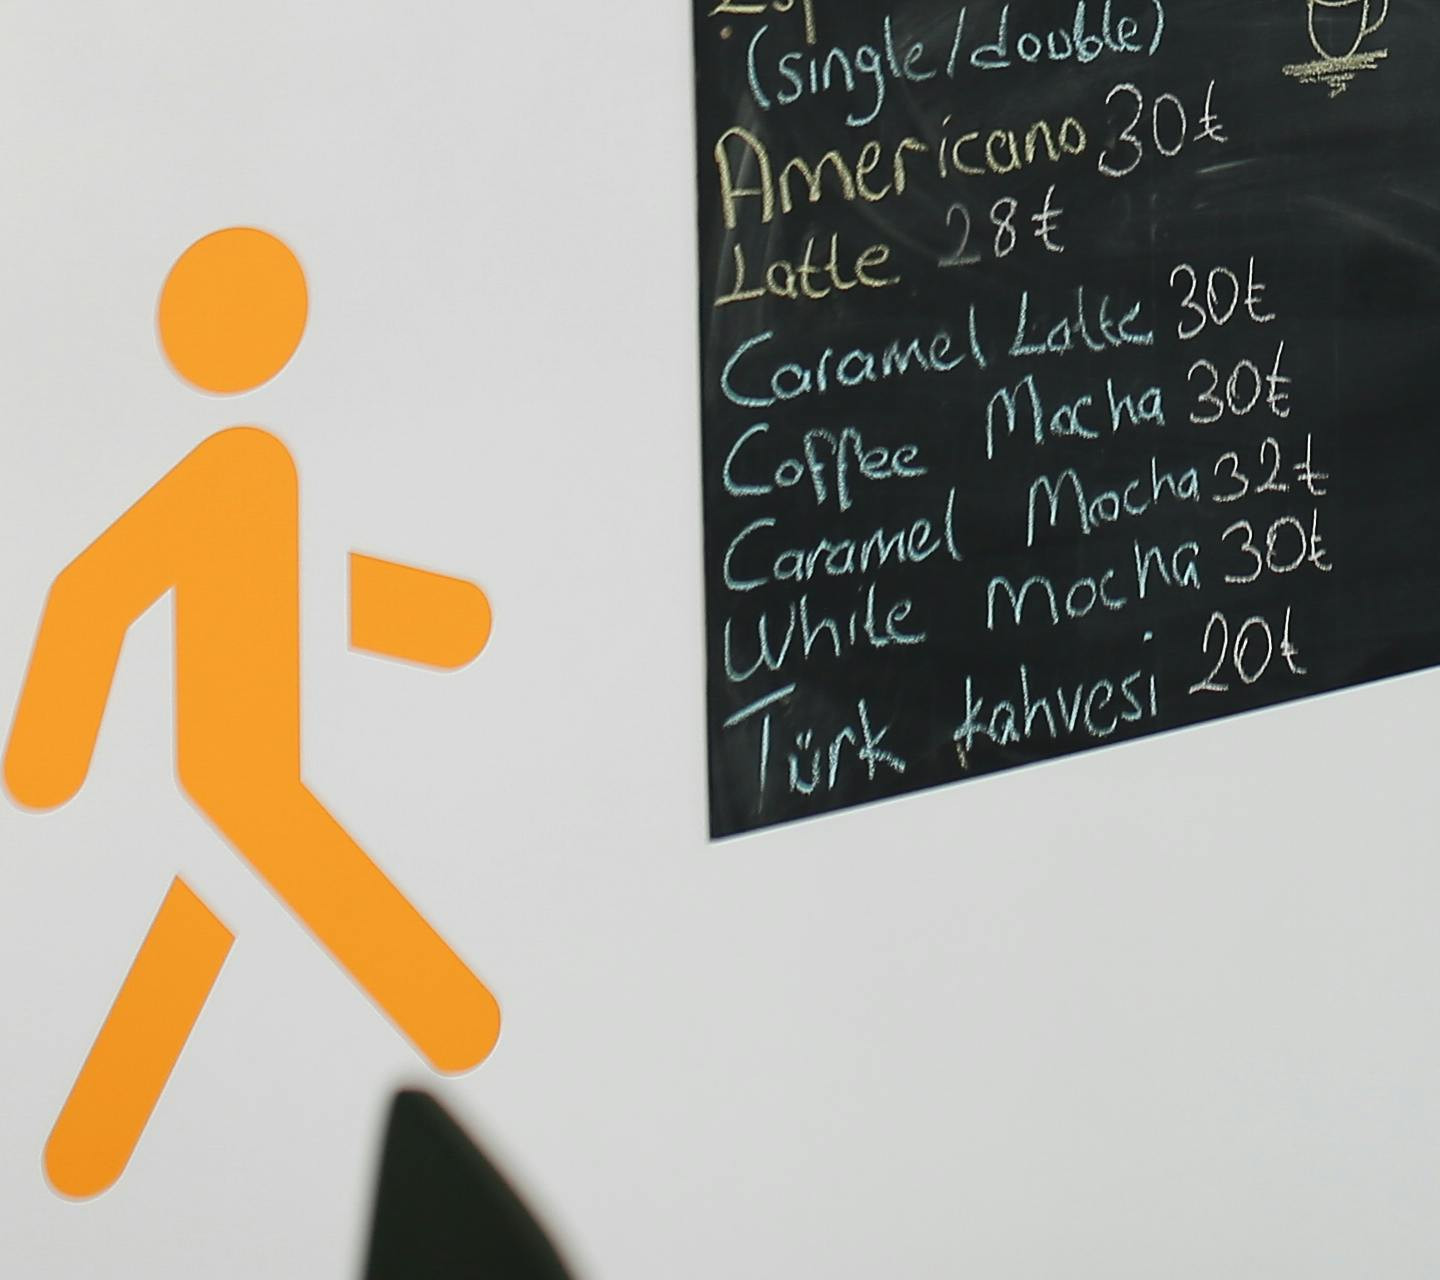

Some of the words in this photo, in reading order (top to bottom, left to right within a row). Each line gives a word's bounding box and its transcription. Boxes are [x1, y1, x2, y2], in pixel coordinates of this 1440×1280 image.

[713, 116, 1088, 230] Americano
[713, 232, 901, 307] Latte
[719, 306, 988, 408] Caramel
[1008, 286, 1155, 357] Latte
[721, 423, 930, 513] Coffee
[985, 374, 1166, 461] Mocha
[723, 487, 962, 591] Caramel
[1026, 456, 1201, 546] Mocha
[722, 683, 907, 796] Türk
